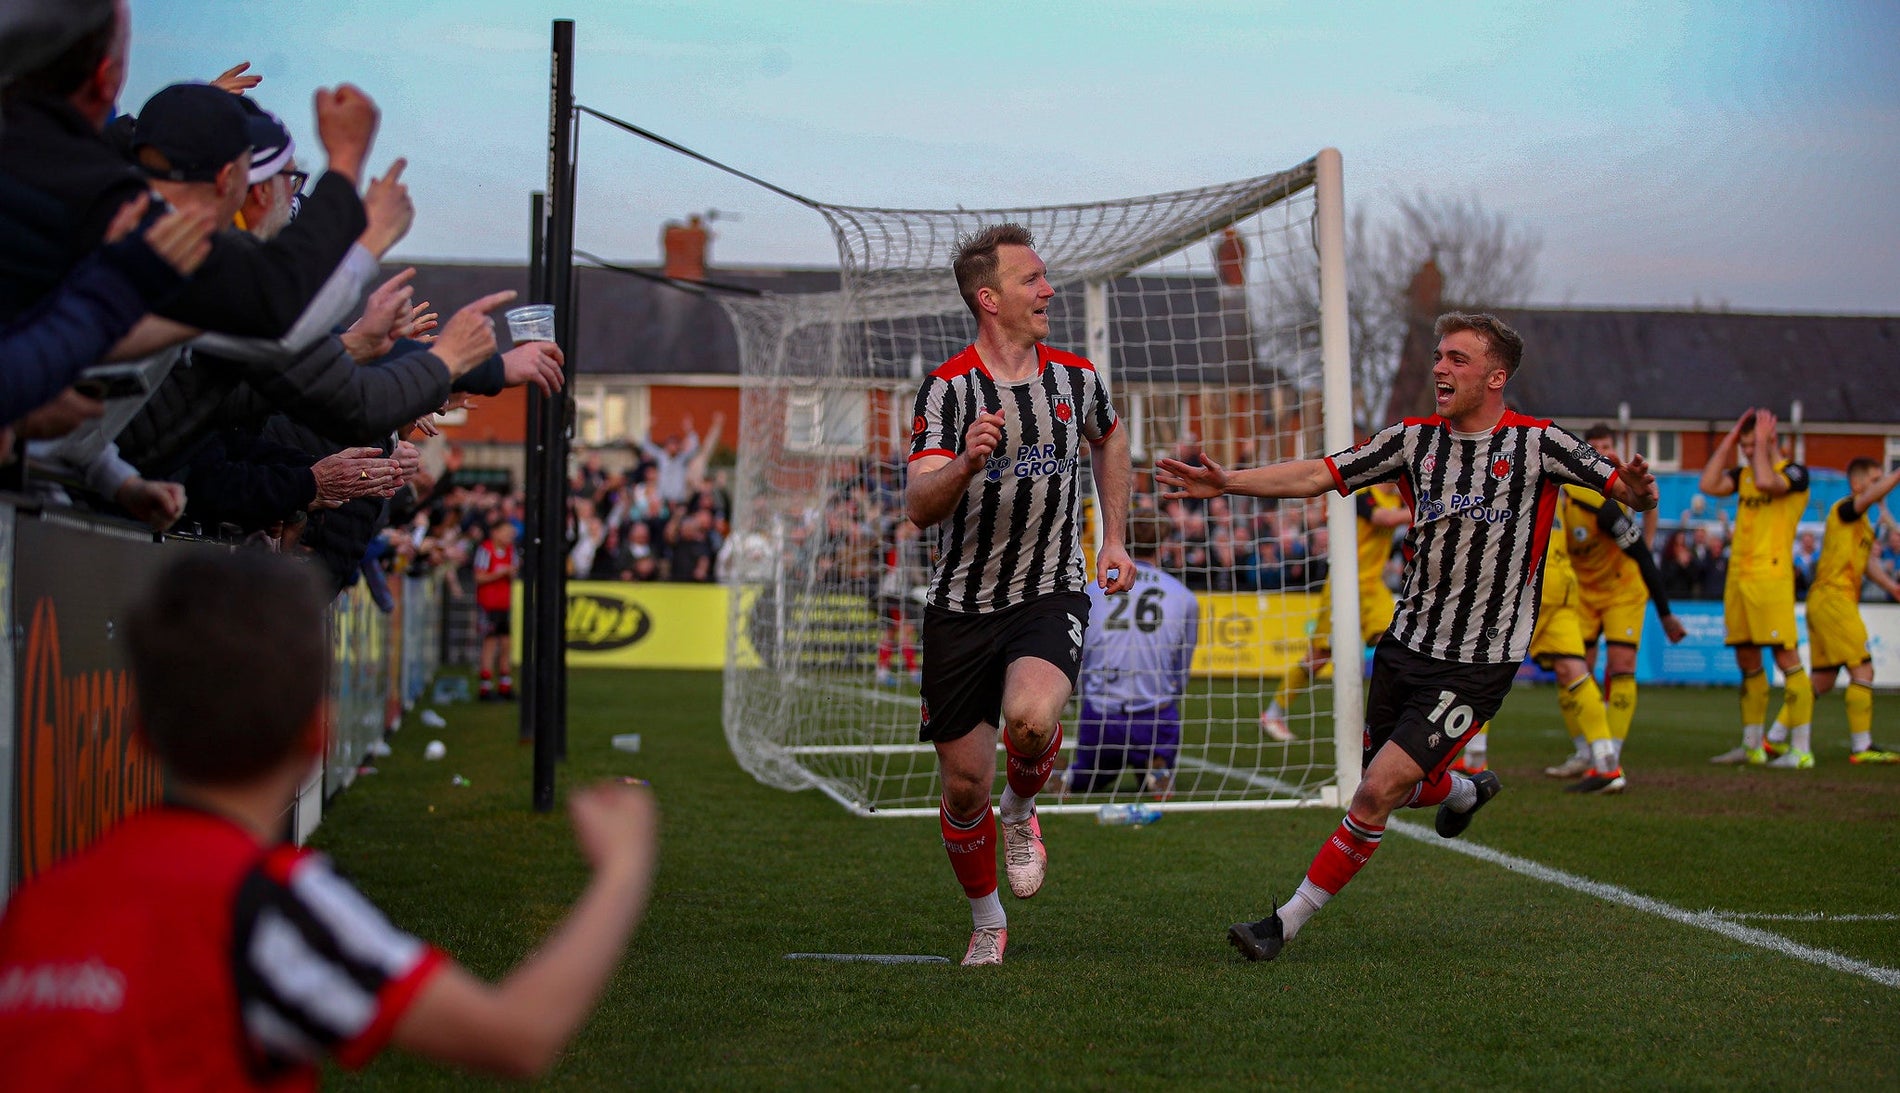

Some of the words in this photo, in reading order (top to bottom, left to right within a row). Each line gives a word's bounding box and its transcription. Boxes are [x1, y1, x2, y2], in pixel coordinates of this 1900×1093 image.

[1017, 443, 1055, 461] PAR
[1013, 459, 1077, 478] GROUP
[1446, 506, 1512, 523] ROUP
[1104, 587, 1165, 633] 26
[1427, 690, 1474, 739] 10
